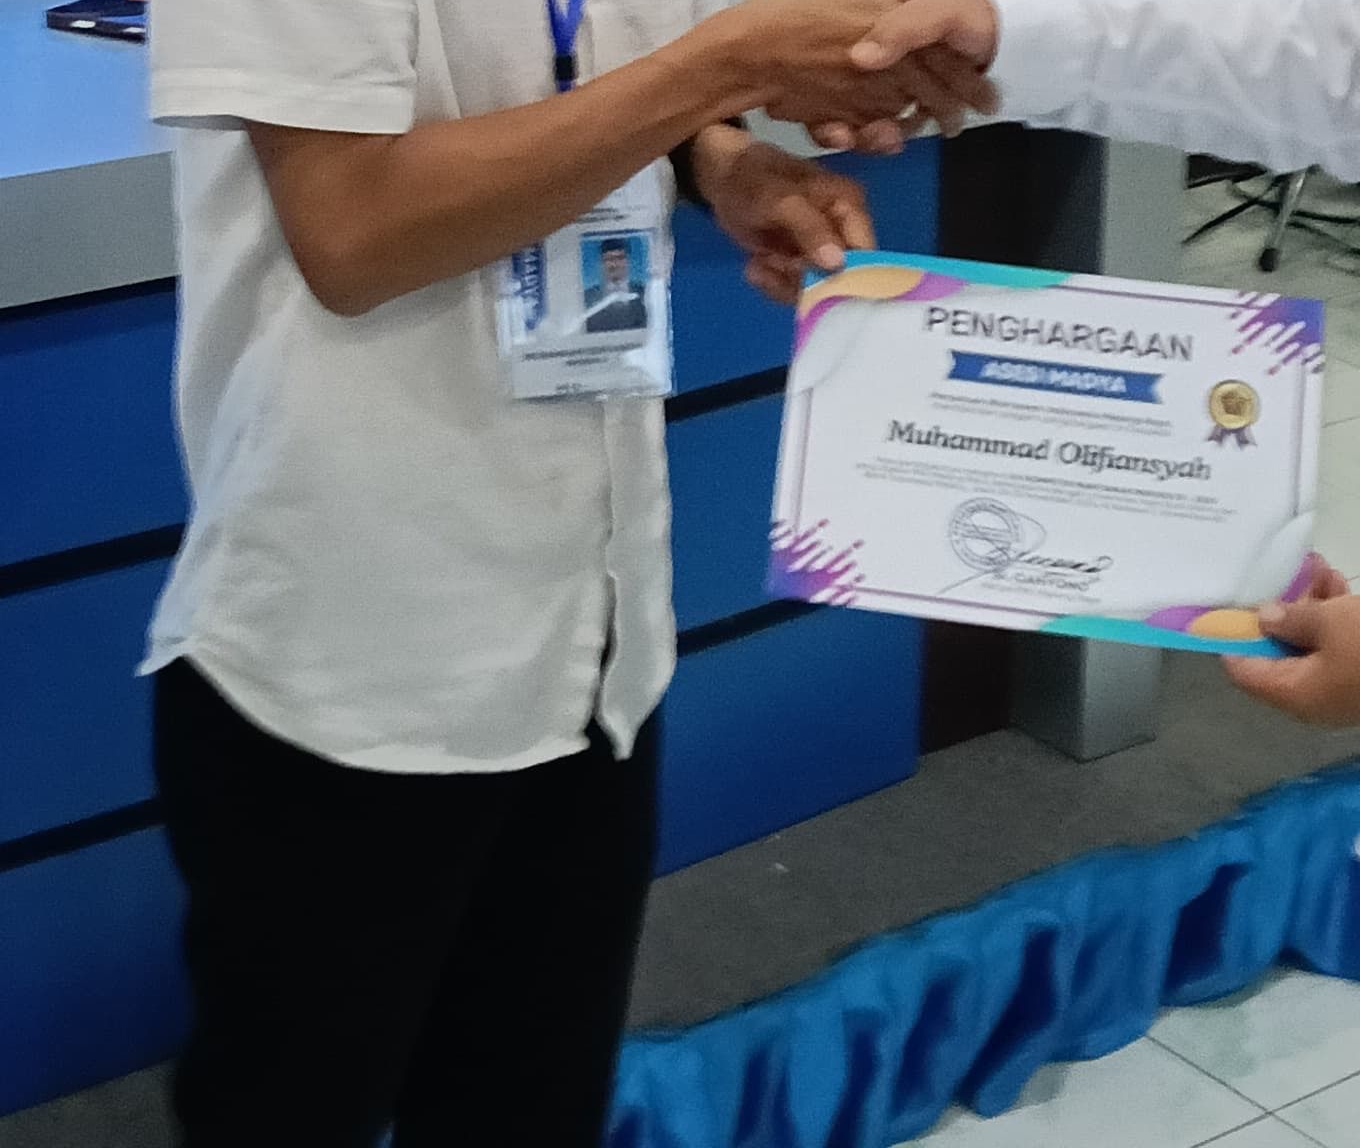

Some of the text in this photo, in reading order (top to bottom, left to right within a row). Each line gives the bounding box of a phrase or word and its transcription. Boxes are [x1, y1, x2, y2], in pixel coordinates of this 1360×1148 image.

[926, 306, 1194, 361] PENGHARGAAN
[887, 420, 1213, 481] Muhammad Olifiansyah
